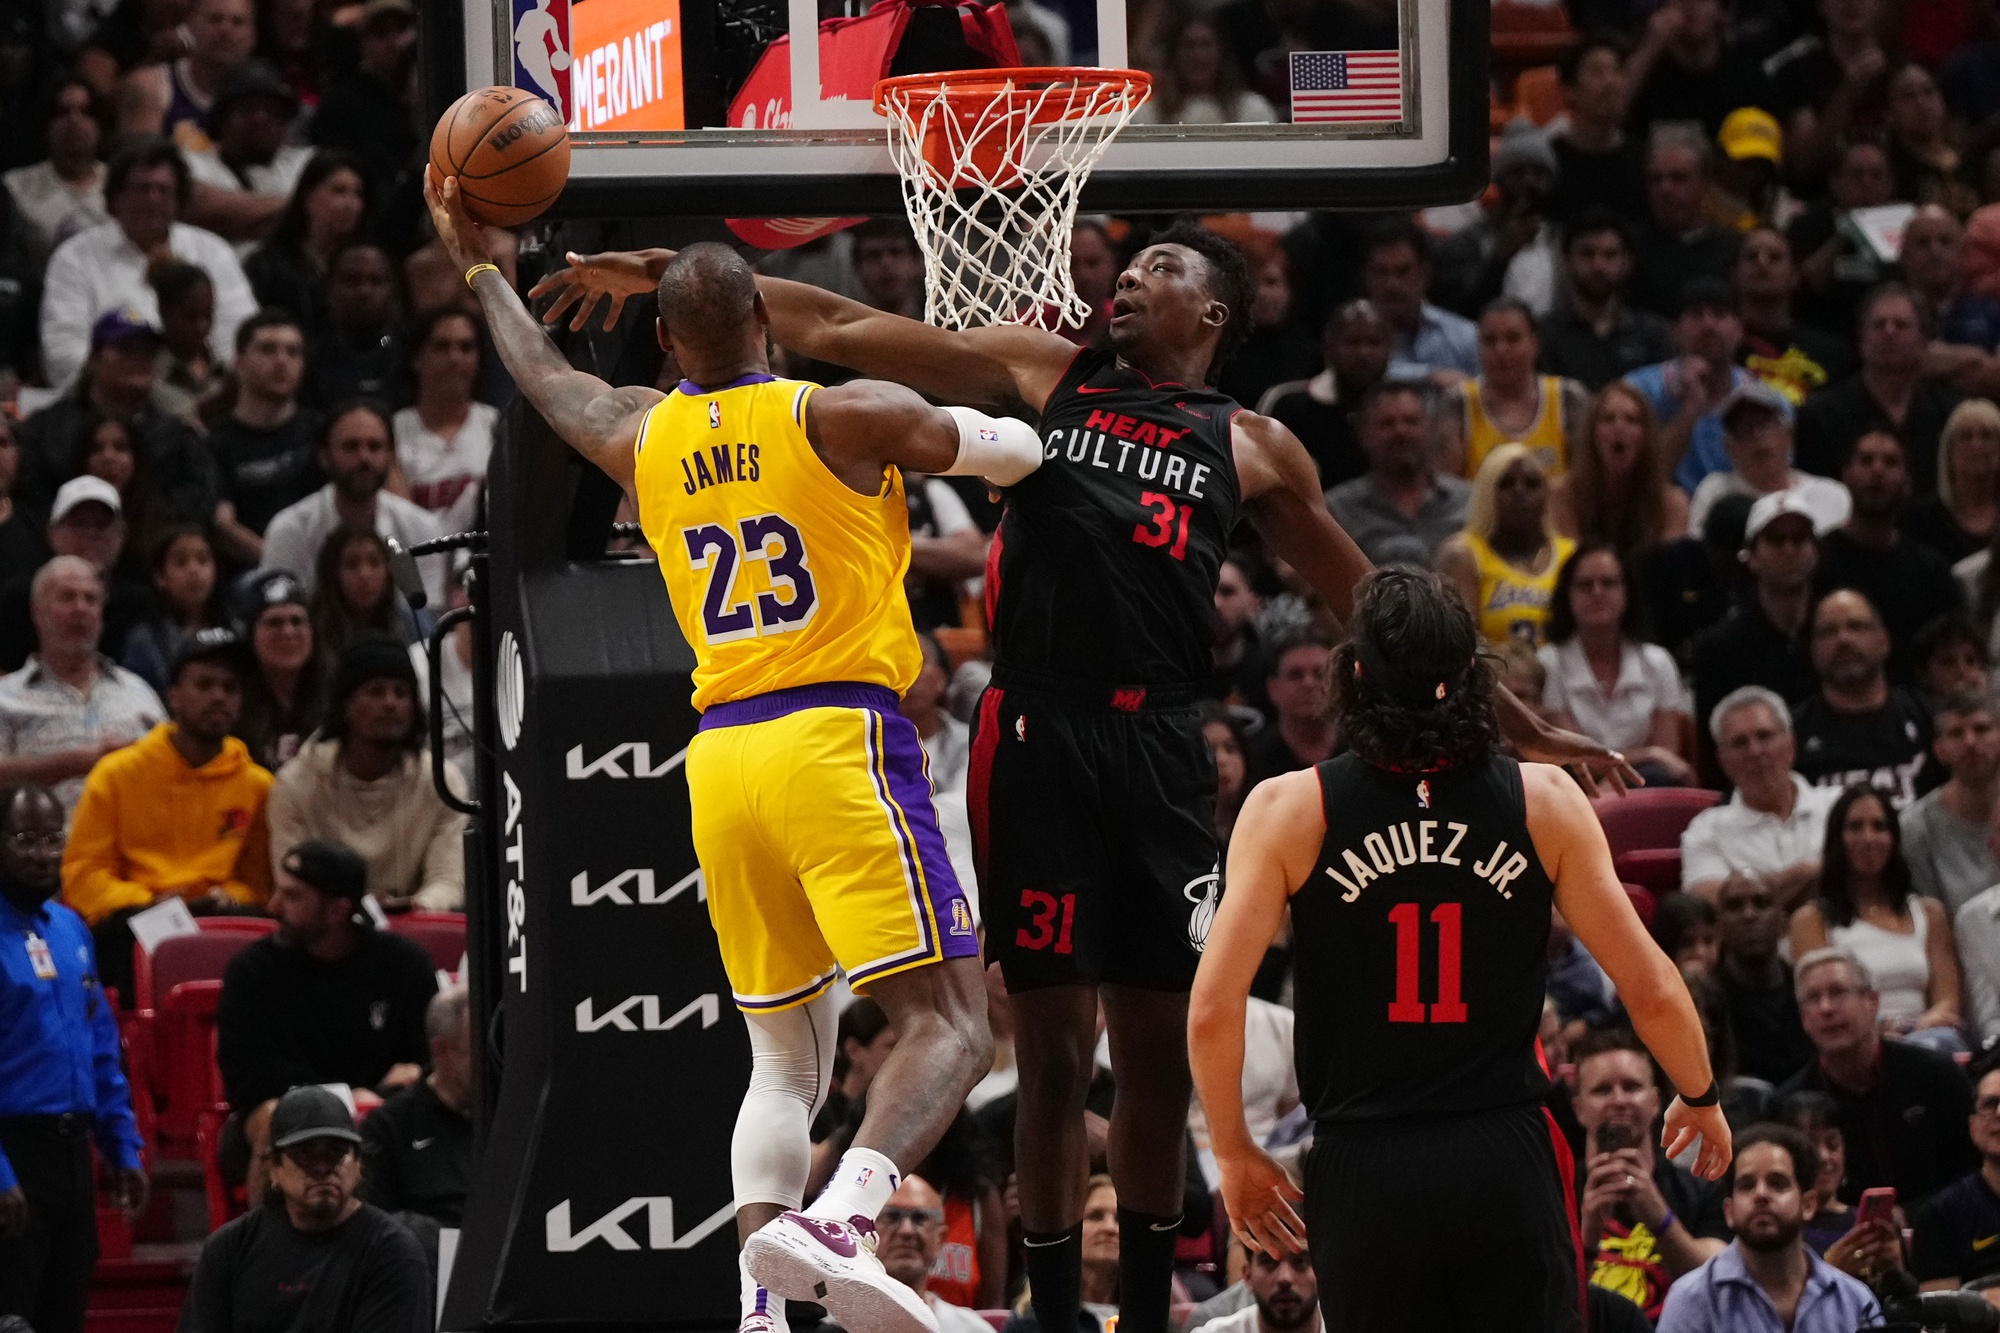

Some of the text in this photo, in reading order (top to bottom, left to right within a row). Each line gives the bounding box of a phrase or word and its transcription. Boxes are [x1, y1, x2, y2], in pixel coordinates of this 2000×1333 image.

[569, 20, 664, 132] MERANT
[1044, 428, 1211, 499] CULTURE
[1085, 409, 1192, 449] HEAT
[681, 443, 760, 495] JAMES
[1132, 490, 1193, 561] 31
[681, 511, 820, 646] 23
[566, 742, 688, 780] KI
[503, 770, 527, 993] AT&T
[1325, 820, 1528, 903] JAQUEZ JR.
[1015, 888, 1076, 955] 31
[1388, 903, 1468, 1023] 11
[575, 993, 720, 1033] KIA
